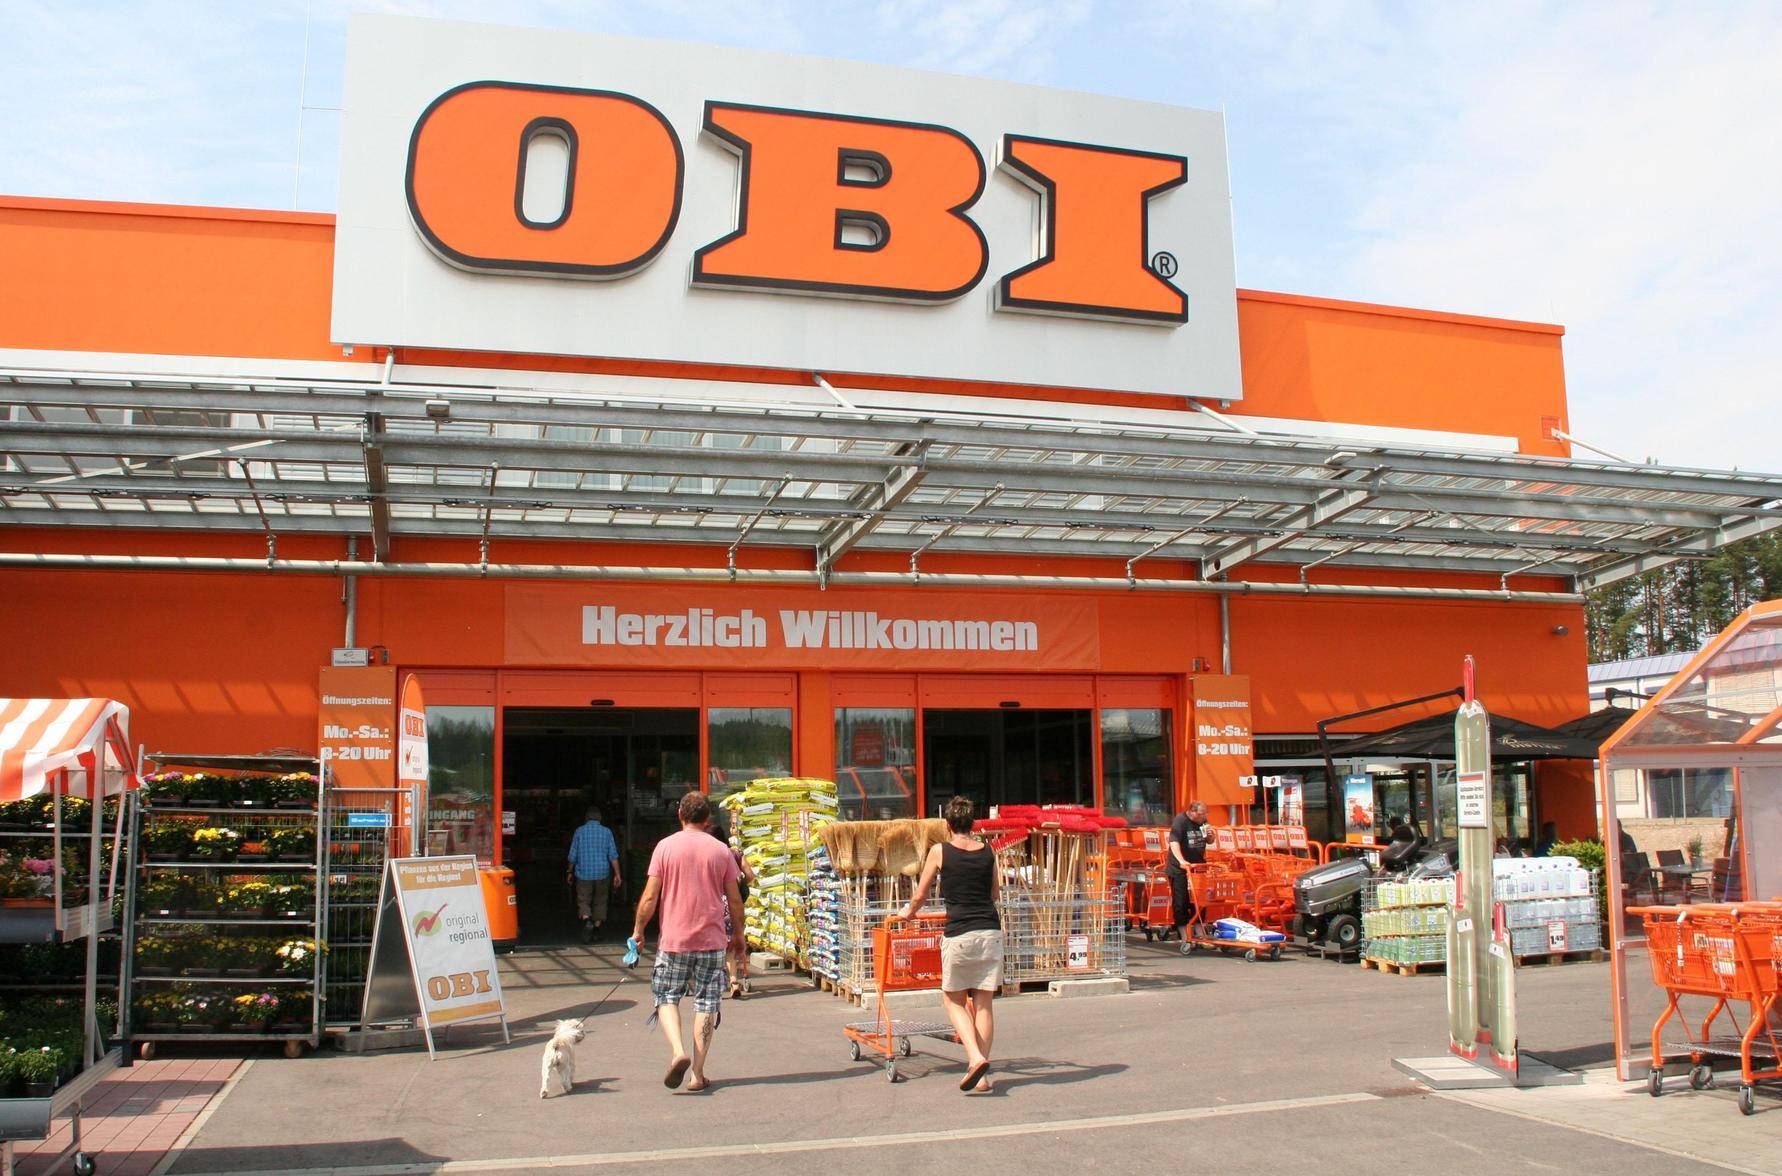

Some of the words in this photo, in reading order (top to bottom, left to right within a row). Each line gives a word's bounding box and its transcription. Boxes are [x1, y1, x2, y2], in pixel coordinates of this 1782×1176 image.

[405, 80, 1188, 326] OBI
[582, 605, 767, 648] Herzlich
[779, 610, 1039, 652] Willkommen
[322, 695, 392, 706] Öffnungszeiten:
[1196, 699, 1249, 709] Öffnungszeiten:
[323, 725, 390, 739] Mo.-Sa.:
[1199, 725, 1248, 737] Mo.-Sa.:
[321, 746, 362, 760] 8-20
[363, 746, 392, 760] Uhr
[1198, 743, 1229, 755] 8-20
[1229, 743, 1250, 755] Uhr
[424, 809, 475, 820] INGANG
[446, 912, 480, 928] original
[449, 928, 488, 944] regional
[1550, 935, 1564, 945] 1.49
[1069, 952, 1088, 961] 4.99
[428, 970, 492, 1001] OBI
